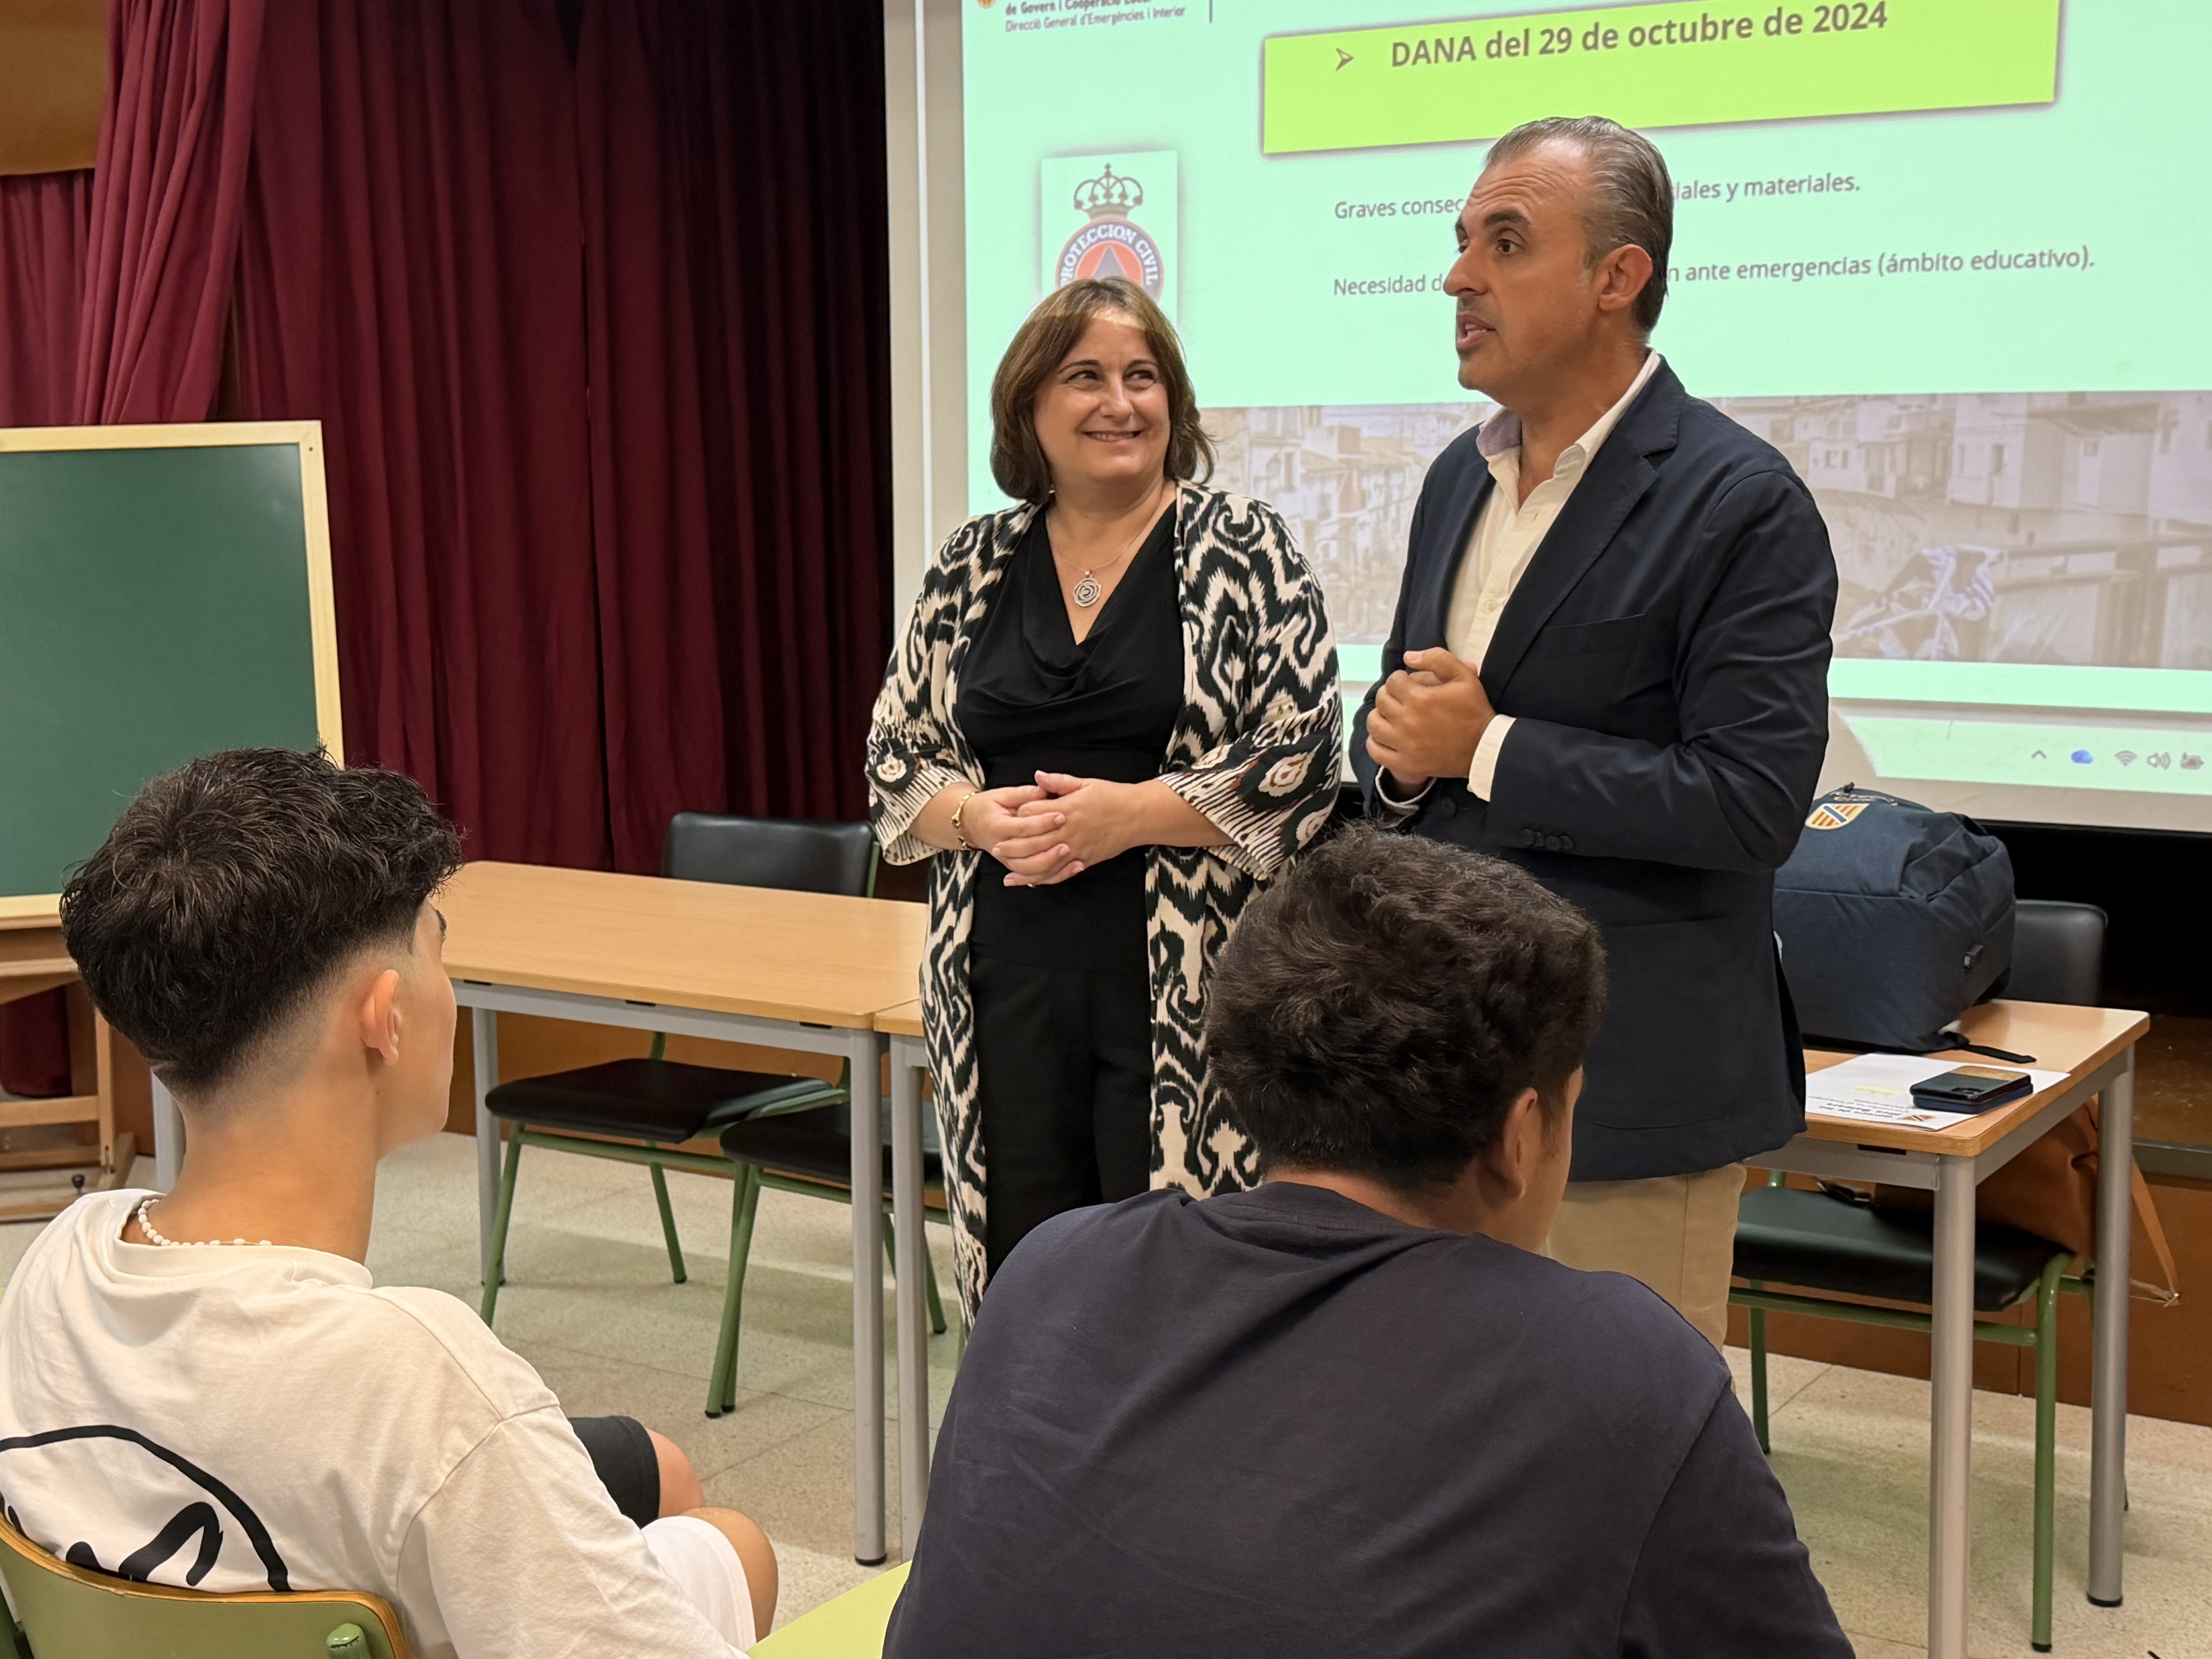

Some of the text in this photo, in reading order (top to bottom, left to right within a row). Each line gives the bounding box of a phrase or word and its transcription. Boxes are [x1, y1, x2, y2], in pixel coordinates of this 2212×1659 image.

[1044, 14, 1077, 29] General
[1153, 7, 1185, 18] Interior
[1391, 0, 1888, 67] DANA del 29 de octubre de 2024
[1334, 172, 1860, 219] Graves consec iales y materiales.
[1135, 240, 1158, 286] CIVIL
[1334, 274, 1426, 295] Necesidad
[1685, 264, 1731, 282] ante
[1736, 256, 1871, 282] emergencias
[1878, 252, 1964, 277] (ámbito
[1970, 245, 2095, 271] educativo).
